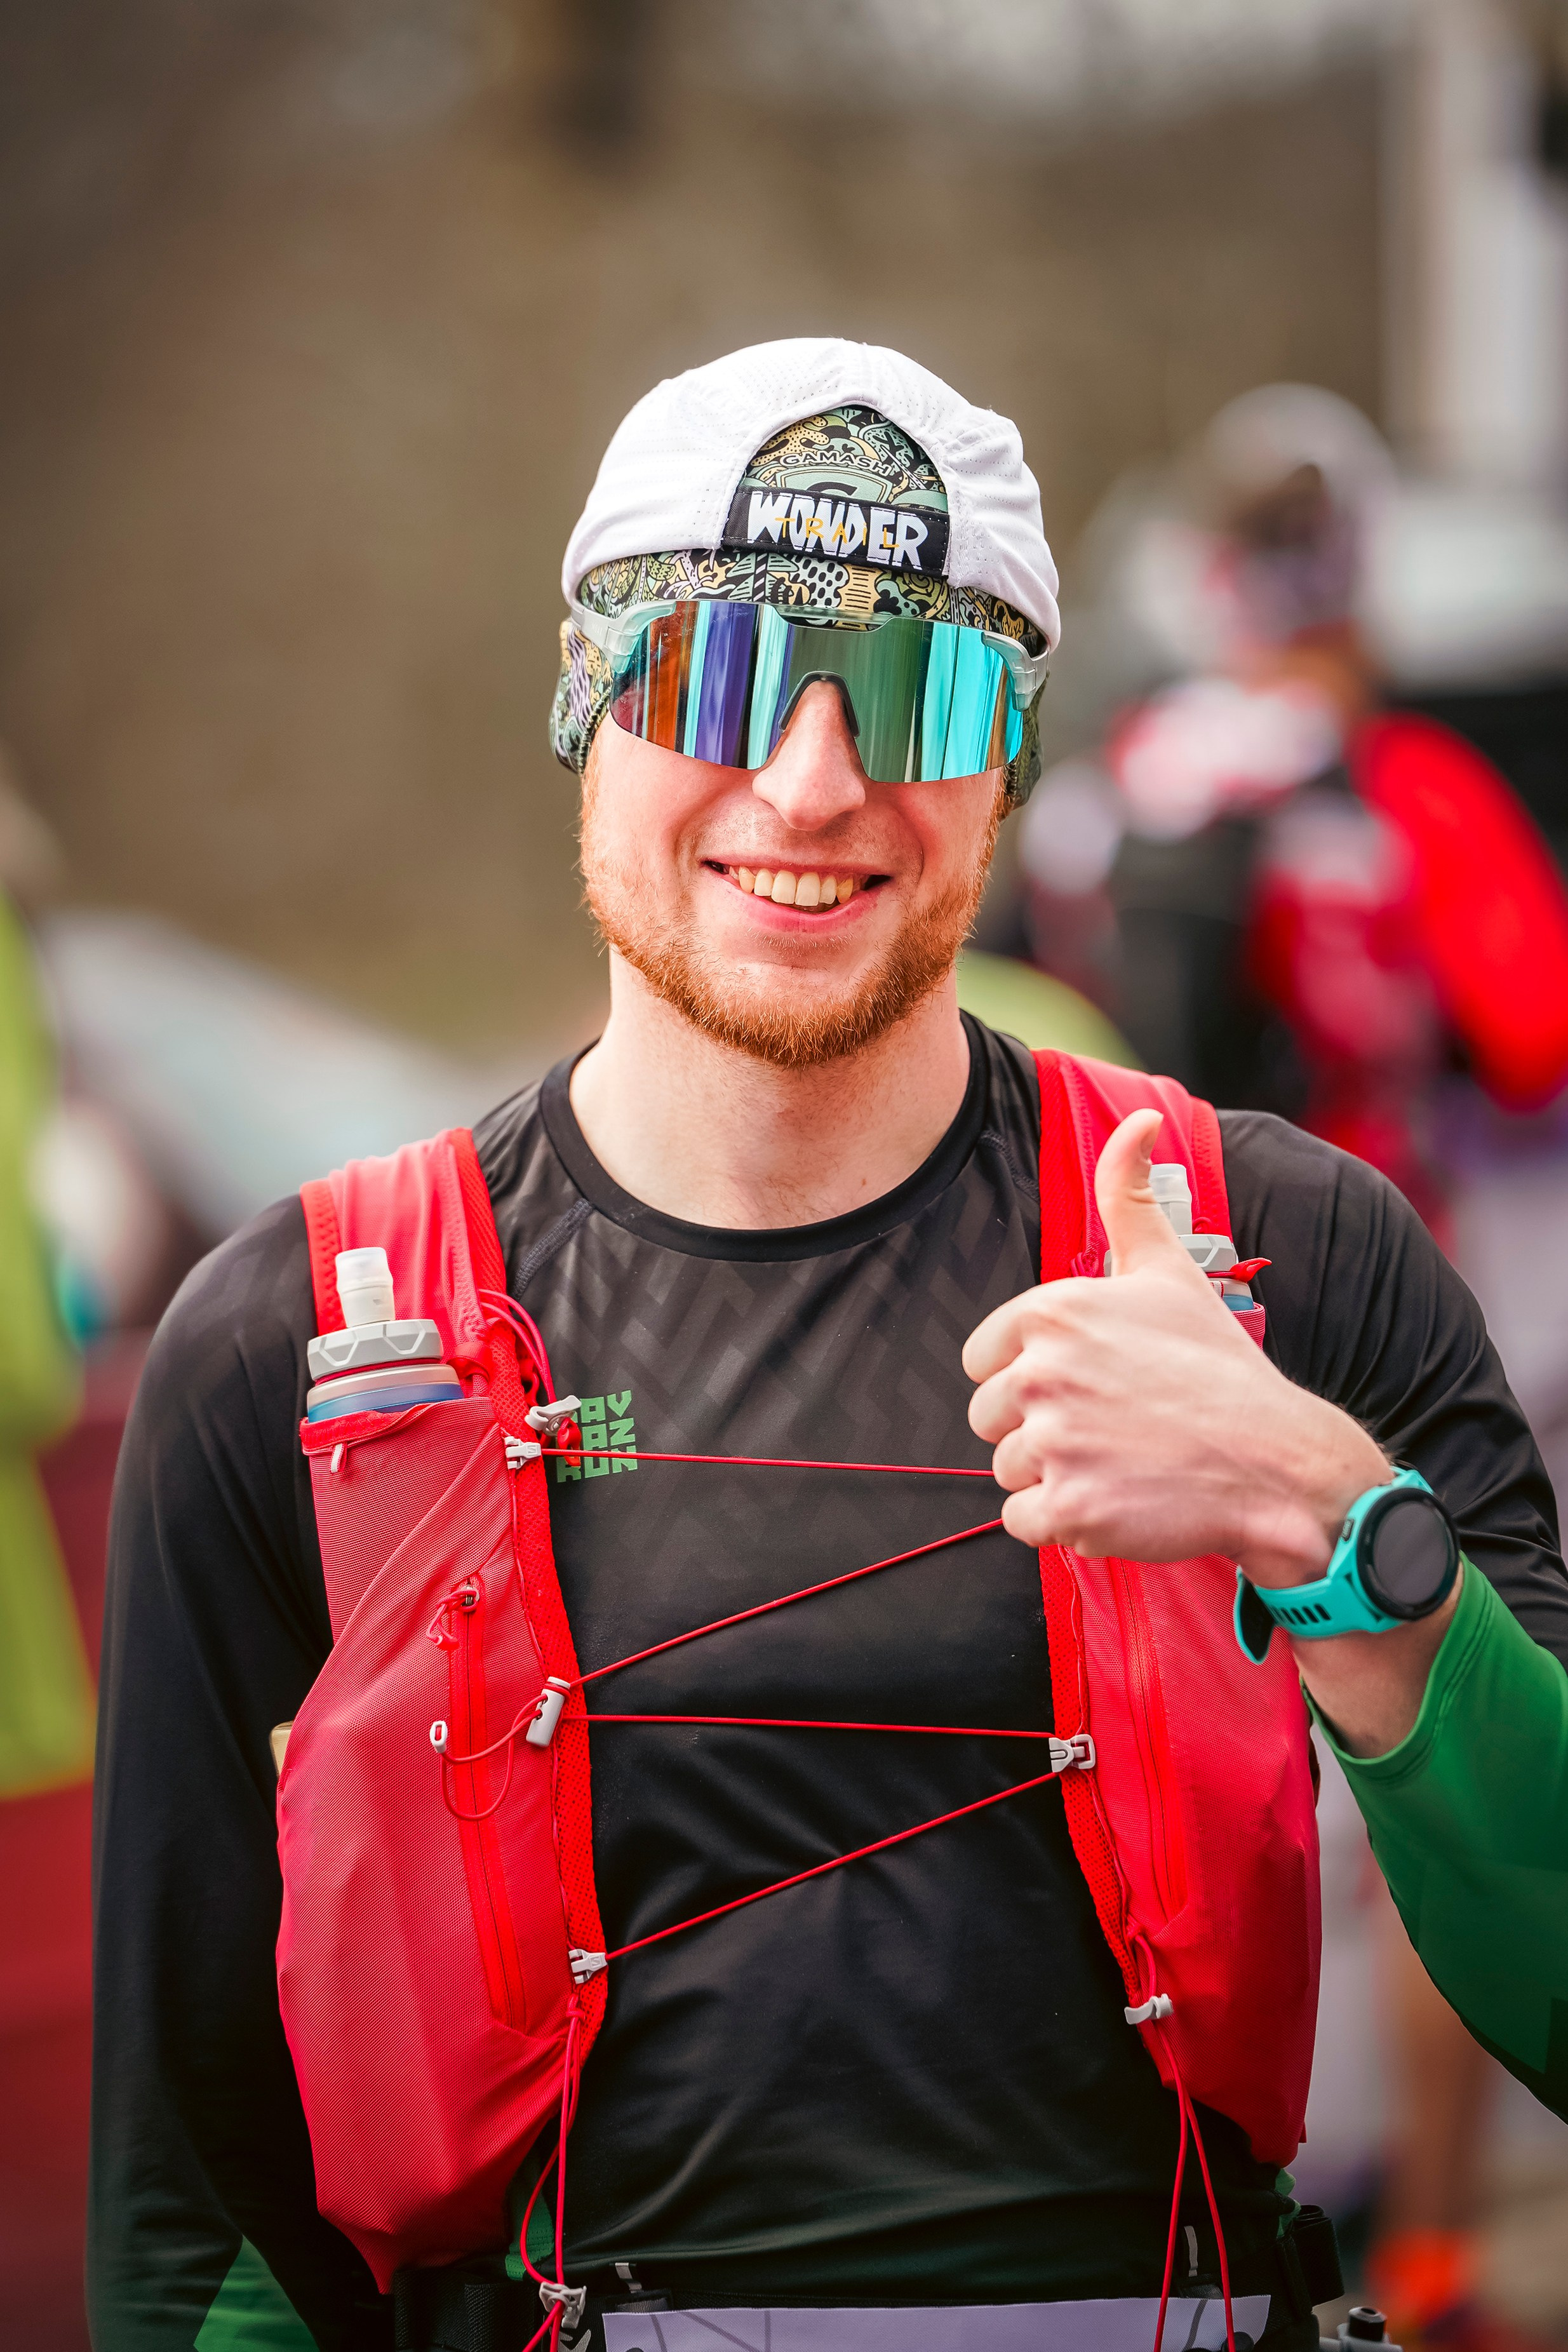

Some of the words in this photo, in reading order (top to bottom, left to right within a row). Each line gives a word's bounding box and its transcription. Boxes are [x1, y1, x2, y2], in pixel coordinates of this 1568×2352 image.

[781, 451, 892, 476] GAMASH
[747, 491, 928, 570] WONDER
[568, 1390, 632, 1423] AV
[556, 1446, 638, 1482] RUN
